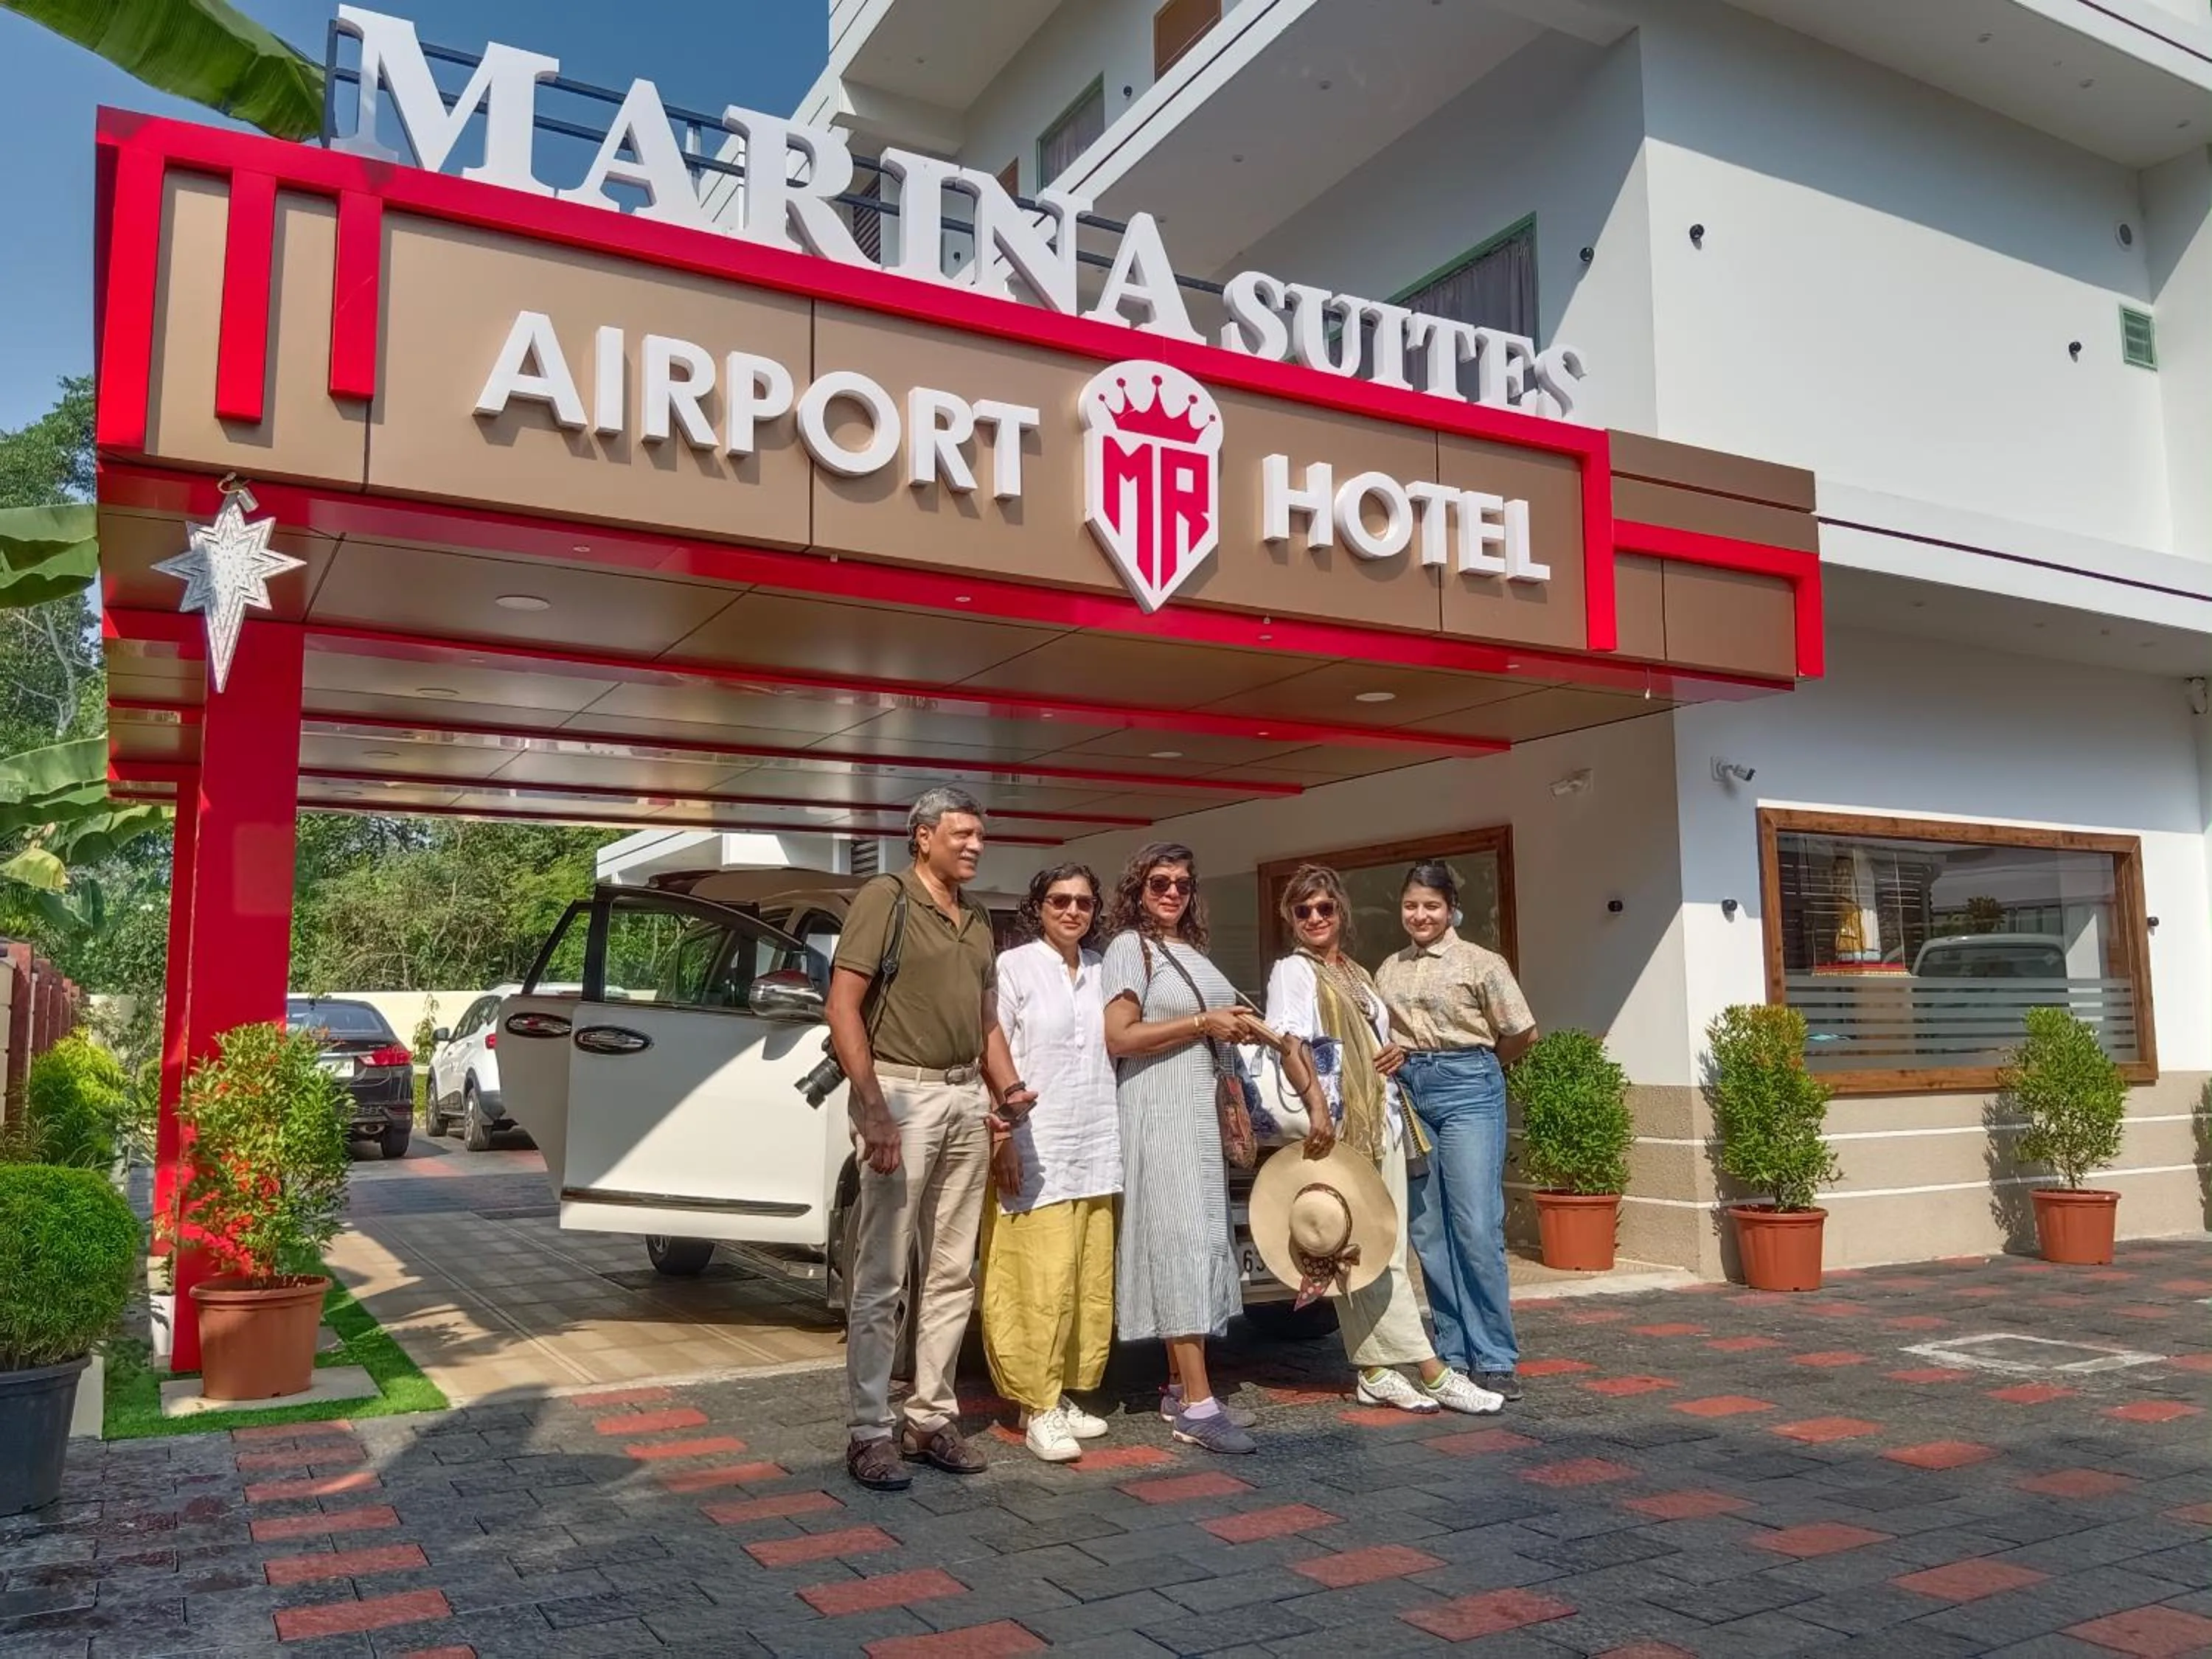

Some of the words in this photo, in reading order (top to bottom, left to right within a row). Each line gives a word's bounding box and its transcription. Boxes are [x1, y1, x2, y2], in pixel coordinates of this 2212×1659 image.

[330, 4, 1206, 347] MARINA
[1220, 271, 1589, 425] SUITES
[473, 311, 1039, 501] AIRPORT
[1263, 453, 1550, 584] HOTEL
